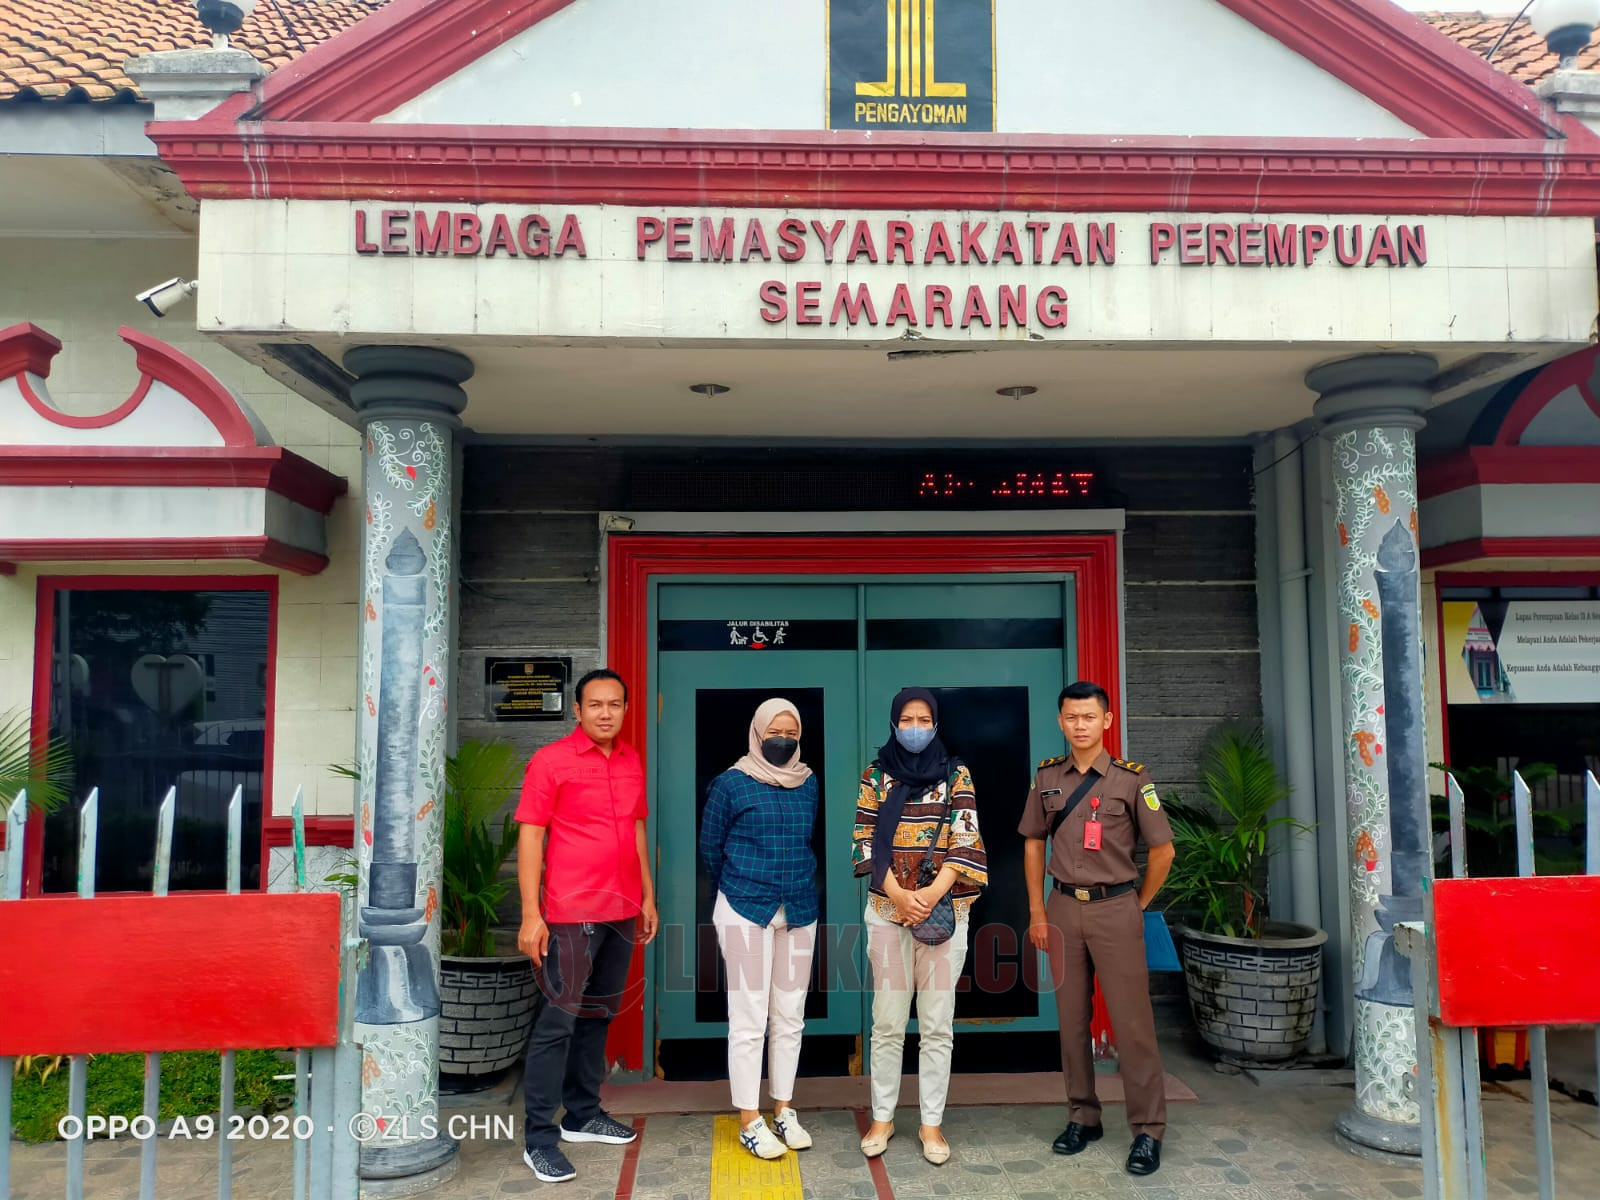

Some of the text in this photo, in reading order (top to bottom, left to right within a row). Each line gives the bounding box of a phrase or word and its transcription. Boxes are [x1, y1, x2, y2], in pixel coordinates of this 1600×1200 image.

[854, 102, 967, 124] PENGAYOMAN
[355, 209, 1428, 268] LEMBAGA PEMASYARAKATAN PEREMPUAN
[759, 279, 1068, 328] SEMARANG
[1533, 612, 1563, 624] Perempuan
[1543, 635, 1558, 644] Anda
[1558, 635, 1578, 644] Adalah
[1536, 664, 1551, 673] Anda
[1552, 664, 1573, 673] Adalah
